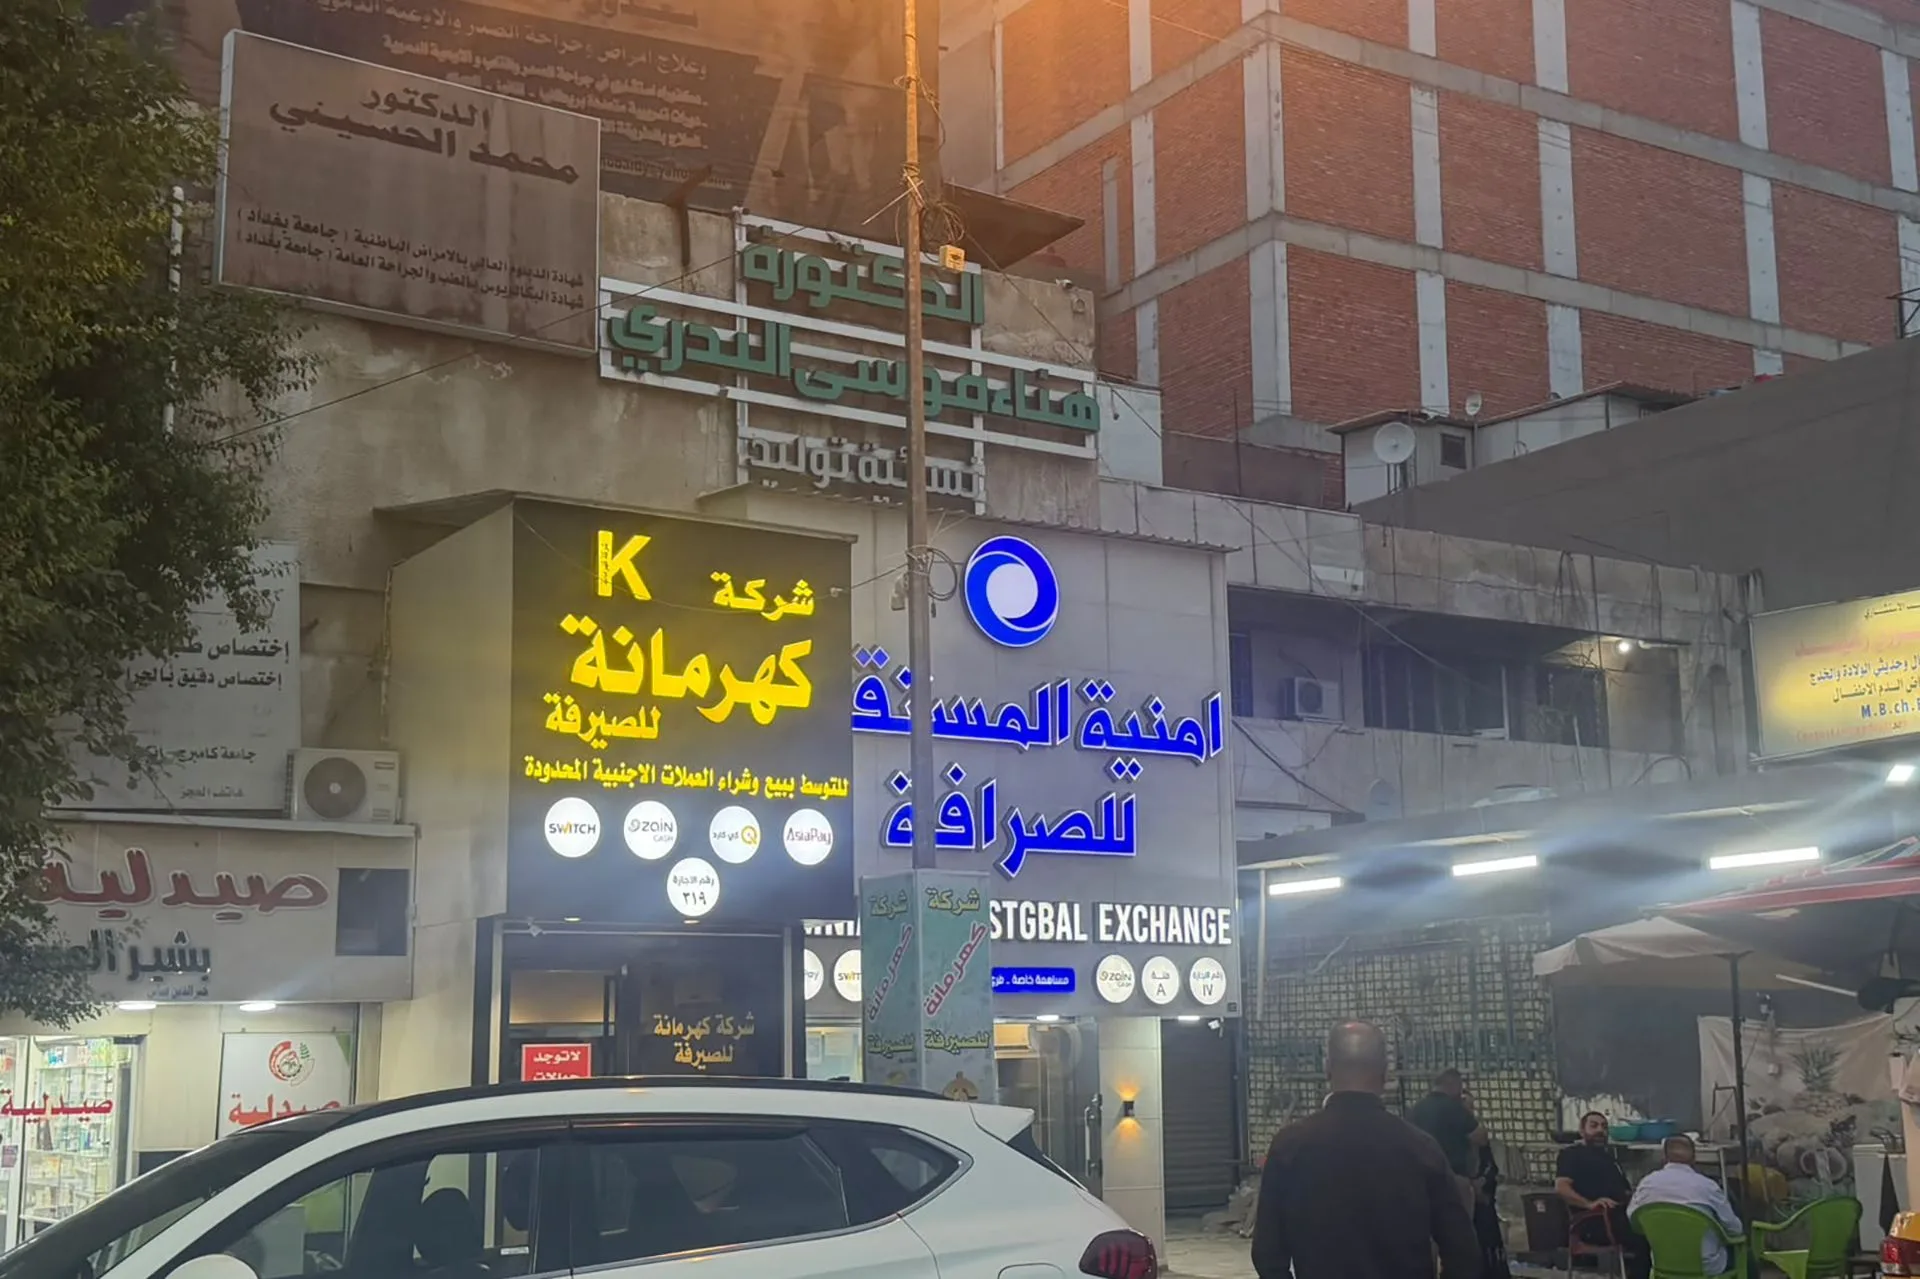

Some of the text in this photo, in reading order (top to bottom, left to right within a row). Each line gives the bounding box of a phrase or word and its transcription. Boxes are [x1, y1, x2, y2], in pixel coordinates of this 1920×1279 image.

[360, 87, 490, 131] الدكتور
[269, 101, 457, 158] الحسيني
[469, 142, 580, 185] محمد
[247, 207, 289, 235] بغداد
[292, 214, 339, 243] جامعة
[245, 230, 281, 253] بغداد
[284, 237, 323, 261] جامعة
[354, 228, 411, 254] الباطنية
[412, 244, 468, 269] بالامراض
[336, 247, 374, 268] العامة
[470, 256, 508, 273] العالي
[551, 269, 584, 288] شهادة
[743, 226, 985, 325] الدكتورة
[551, 292, 584, 310] شهادة
[795, 360, 988, 419] موسى
[986, 367, 1100, 432] هناء
[750, 436, 849, 488] توليد
[597, 529, 653, 601] K
[710, 571, 815, 621] شركة
[207, 637, 289, 664] إختصاص
[177, 668, 215, 688] دقيق
[217, 671, 282, 692] إختصاص
[560, 613, 812, 726] كهرمانة
[543, 692, 662, 750] للصيرفة
[1080, 679, 1224, 780] امنية
[523, 755, 849, 800] للتوسط ببيع وشراء العملات الاجنبية المحدودة
[548, 821, 597, 834] SWITCH
[886, 762, 1137, 878] للصرافة
[868, 889, 908, 920] شركة
[925, 887, 981, 916] شركة
[989, 900, 1233, 945] STGBAL EXCHANGE
[126, 929, 212, 982] بشير
[923, 921, 988, 1017] كهرمانة
[1156, 984, 1167, 996] A
[653, 1010, 755, 1041] شركة كهرمانة
[673, 1042, 734, 1070] للصيرفة
[924, 1028, 990, 1055] للصيرفة
[0, 1088, 114, 1124] صيدلية
